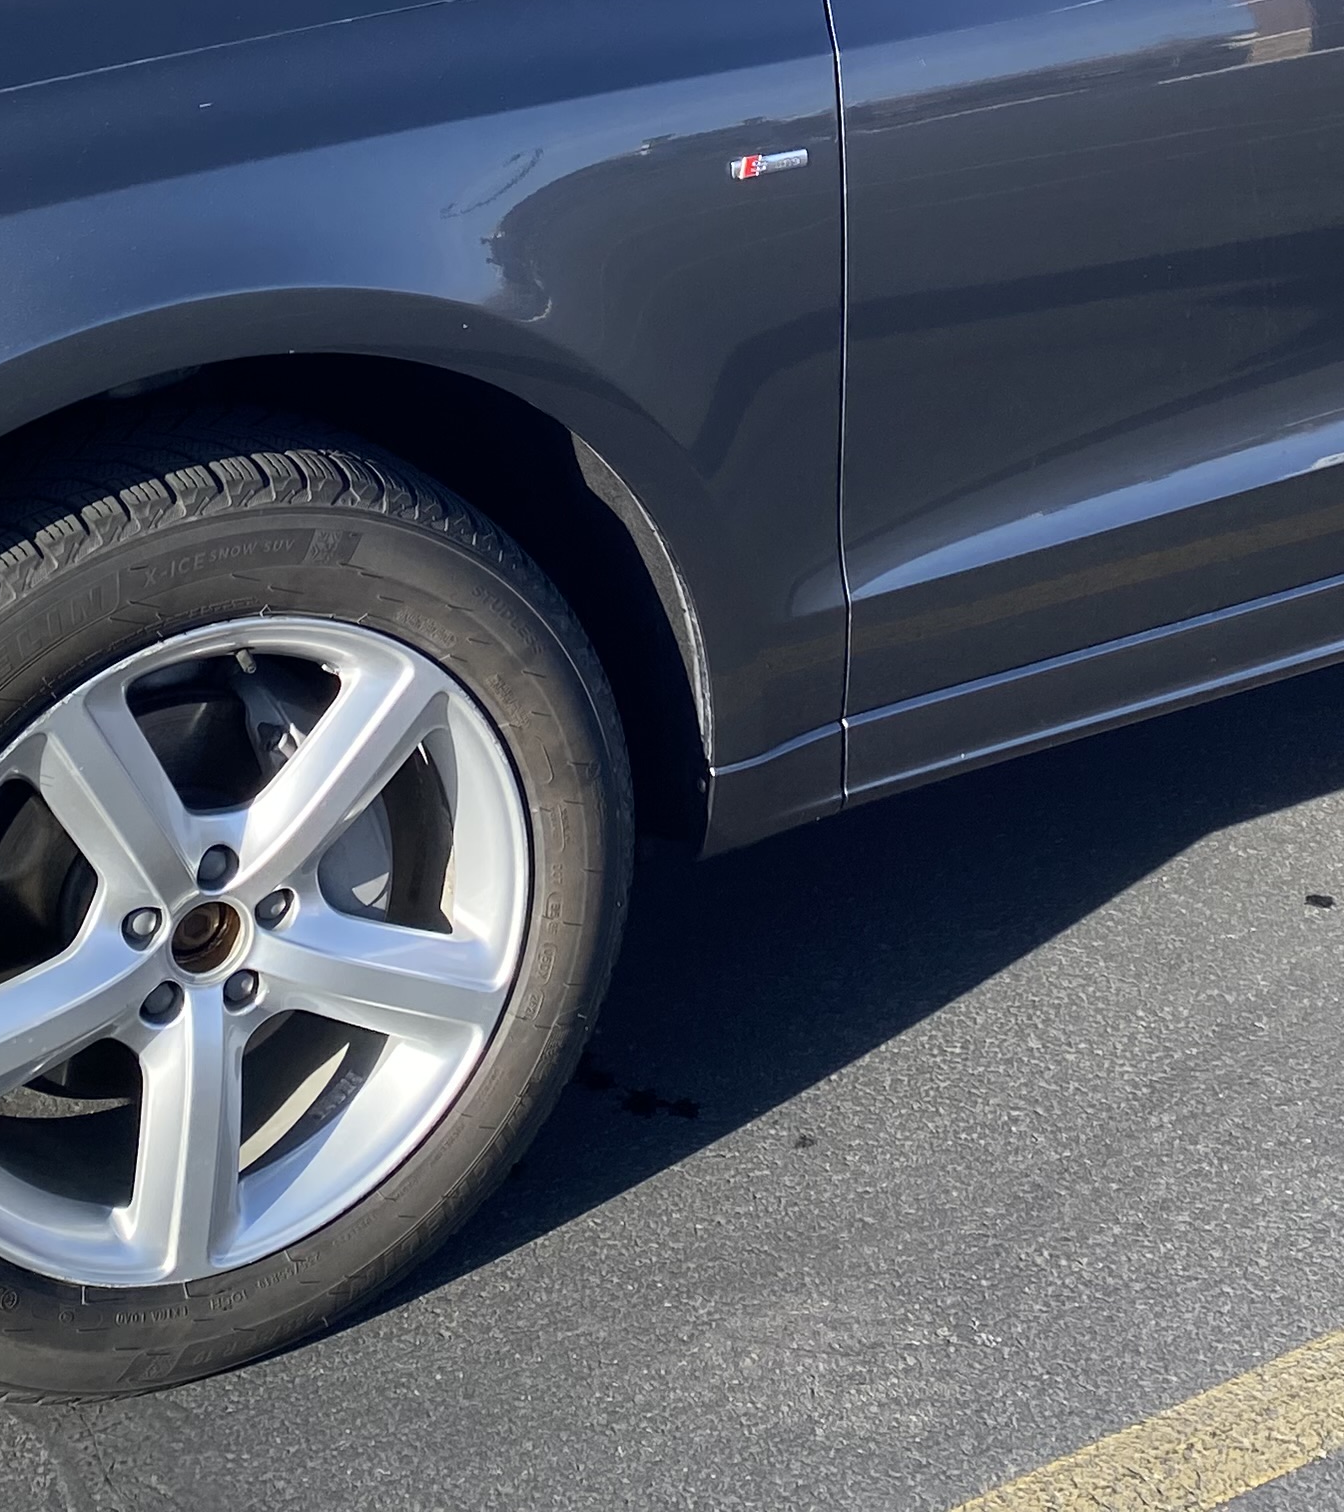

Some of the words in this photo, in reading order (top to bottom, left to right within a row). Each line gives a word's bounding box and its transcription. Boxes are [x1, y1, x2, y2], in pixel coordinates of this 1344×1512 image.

[143, 552, 207, 587] X-ICE
[210, 541, 259, 564] SNOW
[262, 539, 296, 554] SUV
